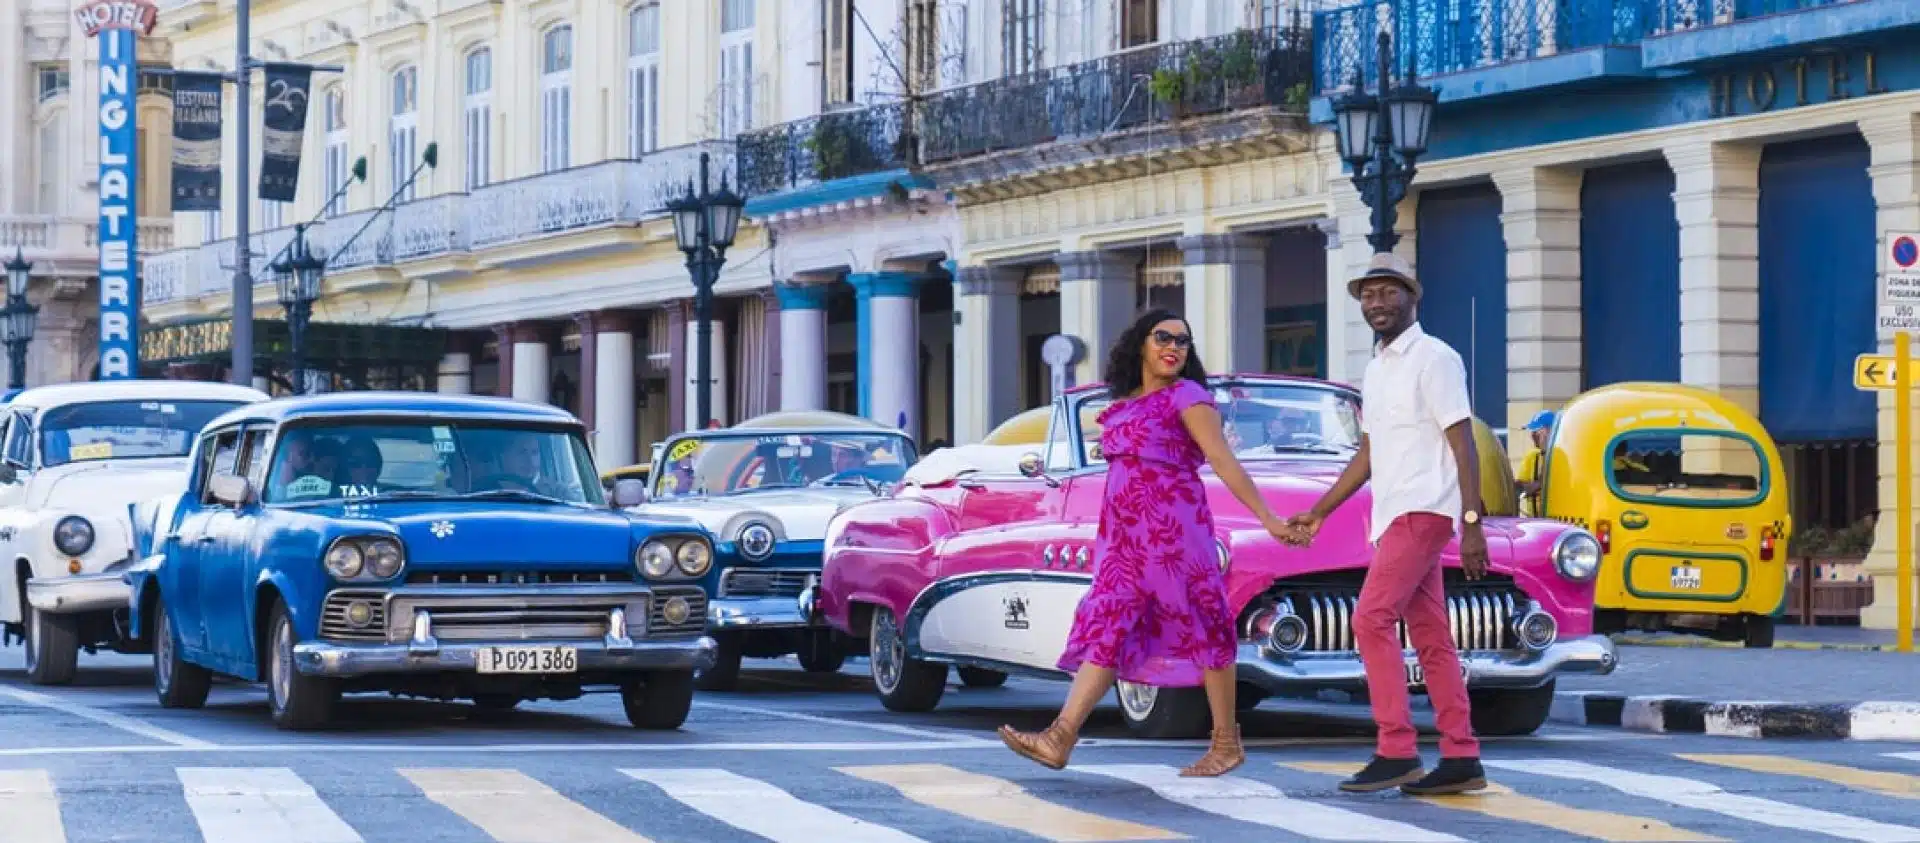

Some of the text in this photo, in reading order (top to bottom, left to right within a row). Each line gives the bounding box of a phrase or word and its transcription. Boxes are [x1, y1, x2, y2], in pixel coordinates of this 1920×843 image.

[74, 2, 146, 31] HOTEL
[1711, 53, 1888, 118] HOTEL
[176, 89, 217, 106] FESTIVAL
[101, 30, 128, 377] INGLATERRA
[1888, 277, 1909, 286] ZONA
[1895, 305, 1913, 316] USO
